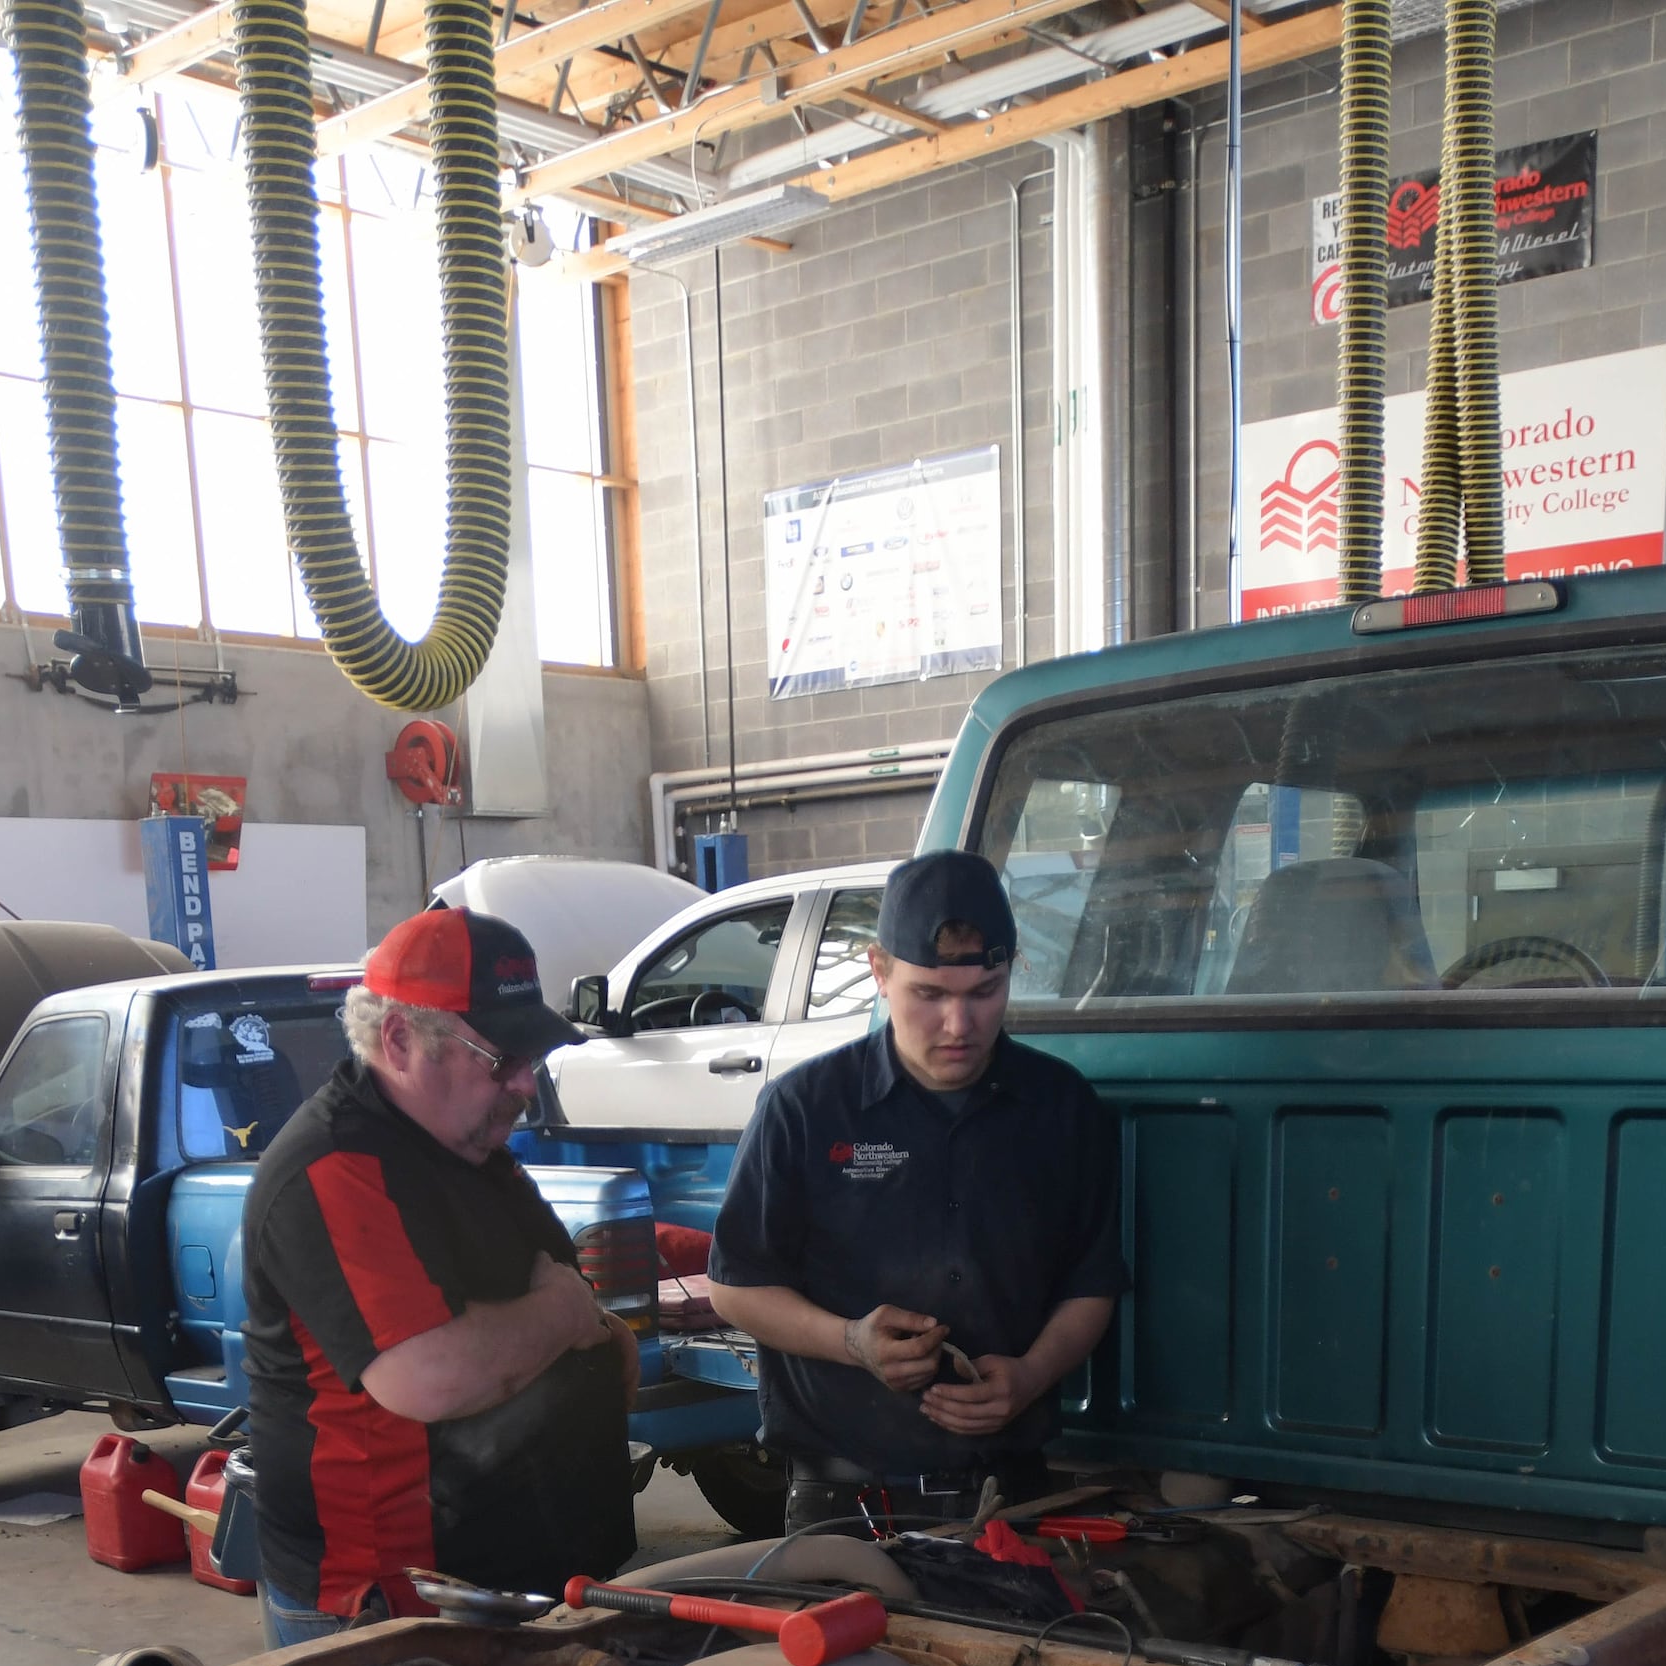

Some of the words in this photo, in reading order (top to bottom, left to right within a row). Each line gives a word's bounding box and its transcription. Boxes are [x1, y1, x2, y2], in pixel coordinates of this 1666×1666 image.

[1494, 165, 1541, 193] rado
[1494, 180, 1588, 214] hwestern
[1511, 222, 1579, 253] Diesel
[1501, 407, 1595, 450] orado
[1542, 486, 1631, 515] College
[179, 831, 202, 916] BEND
[853, 1142, 894, 1152] Colorado
[853, 1150, 910, 1161] Northwestern
